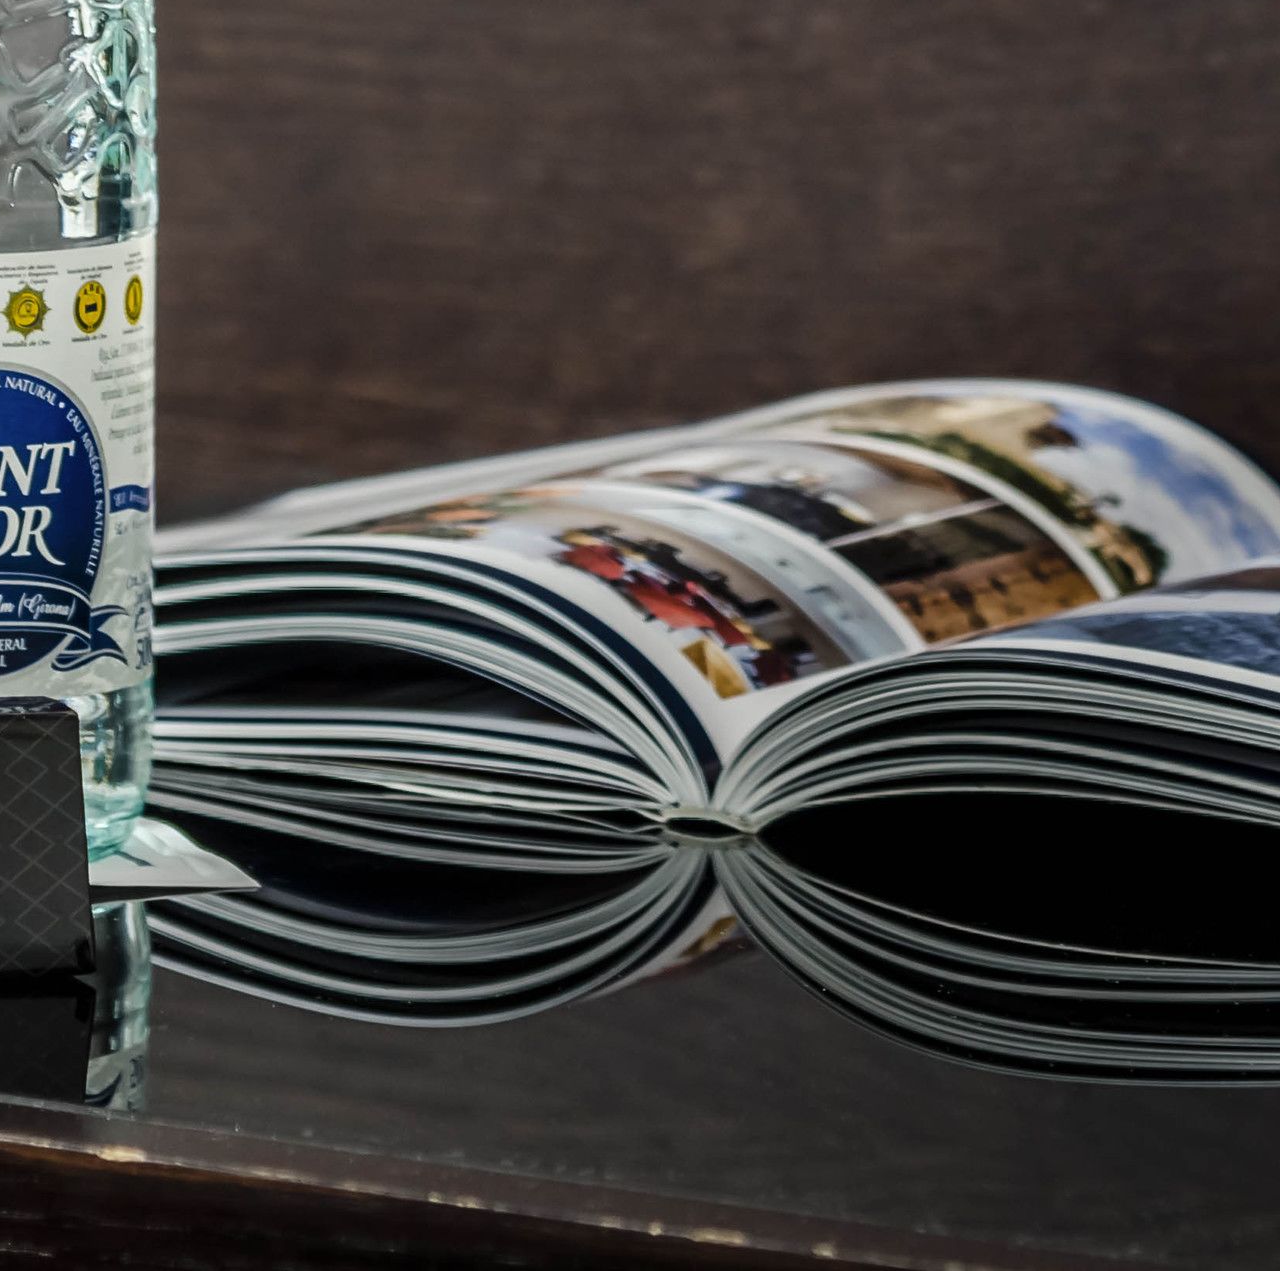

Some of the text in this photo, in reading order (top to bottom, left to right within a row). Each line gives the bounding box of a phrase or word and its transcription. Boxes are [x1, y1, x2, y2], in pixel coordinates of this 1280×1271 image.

[4, 376, 56, 406] NATURAL
[66, 408, 83, 433] EAU
[85, 499, 104, 577] NATURELLE
[18, 592, 76, 621] (Girona)
